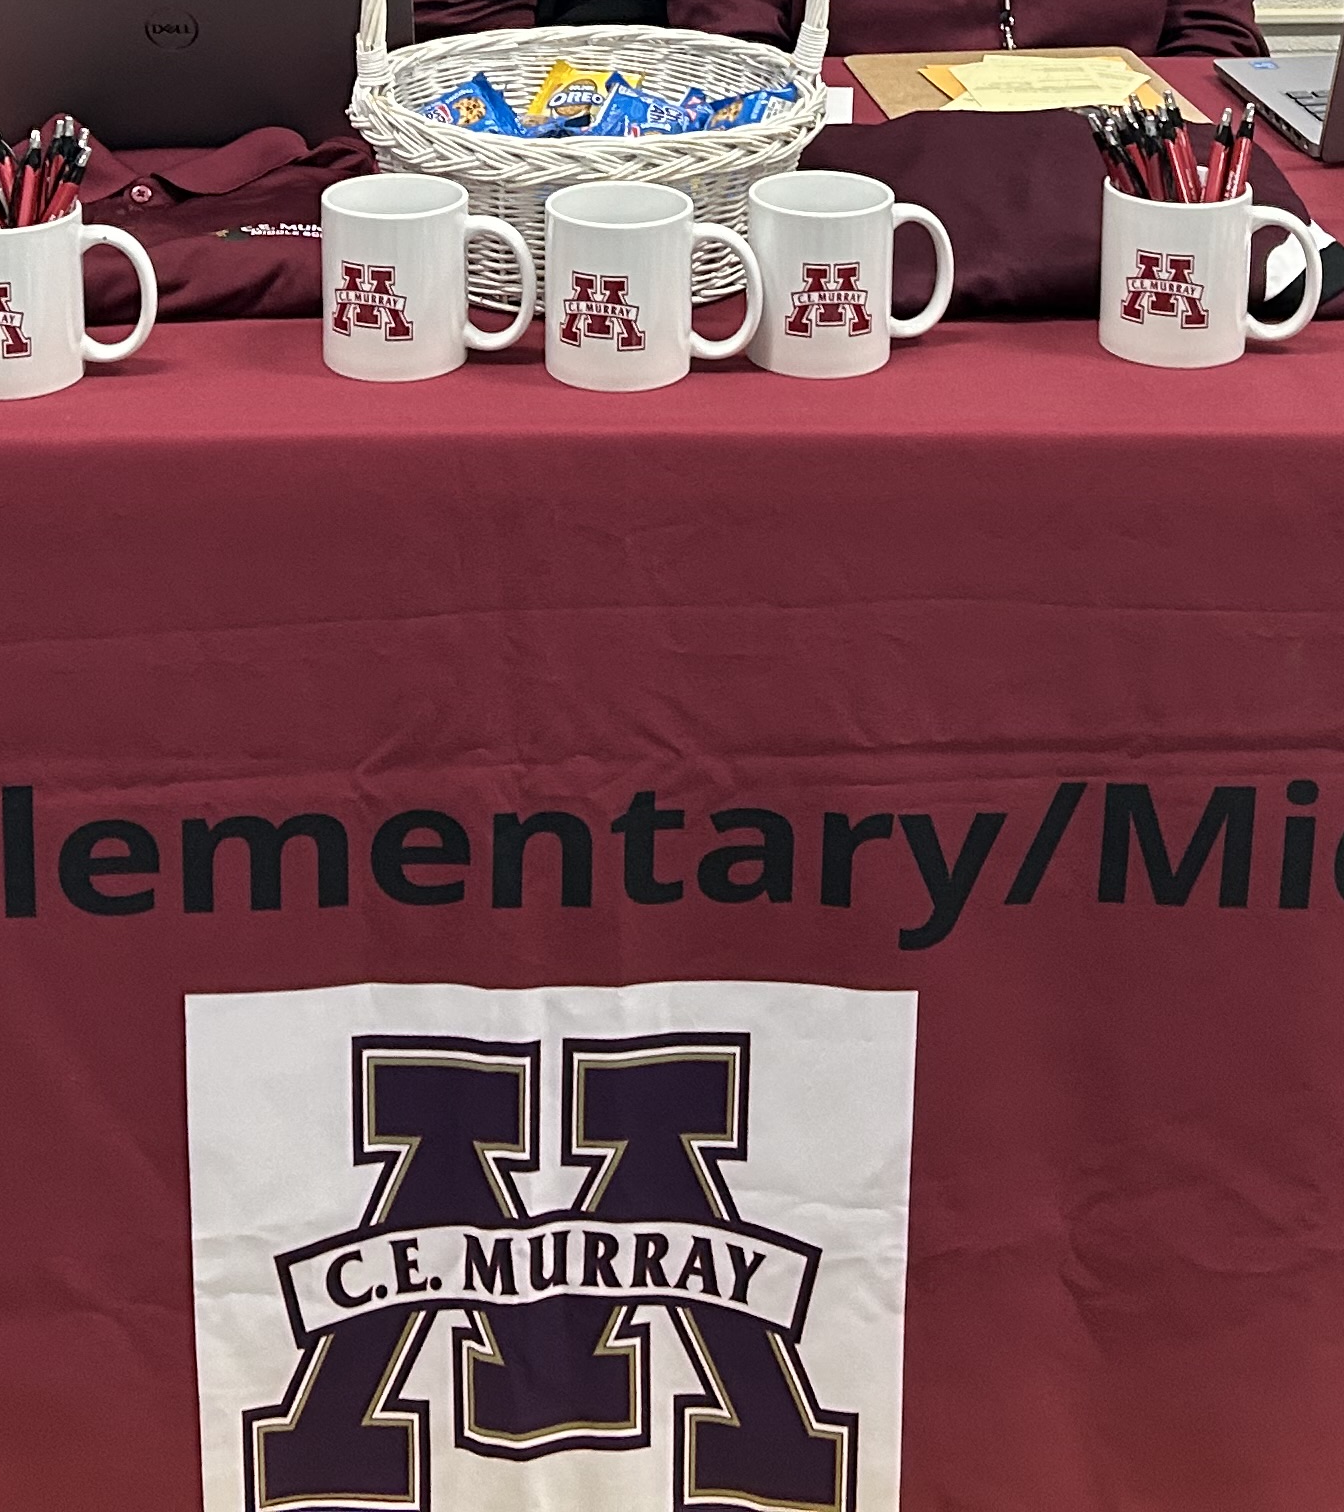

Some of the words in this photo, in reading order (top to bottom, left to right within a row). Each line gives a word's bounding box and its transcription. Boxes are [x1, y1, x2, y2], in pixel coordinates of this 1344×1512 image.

[548, 91, 604, 107] OREO
[1150, 281, 1197, 296] MURRAY
[354, 293, 399, 308] MURRAY
[817, 292, 862, 303] MURRAY
[585, 304, 632, 318] MURRAY
[325, 1237, 443, 1309] C.E.
[462, 1228, 768, 1306] MURRAY
